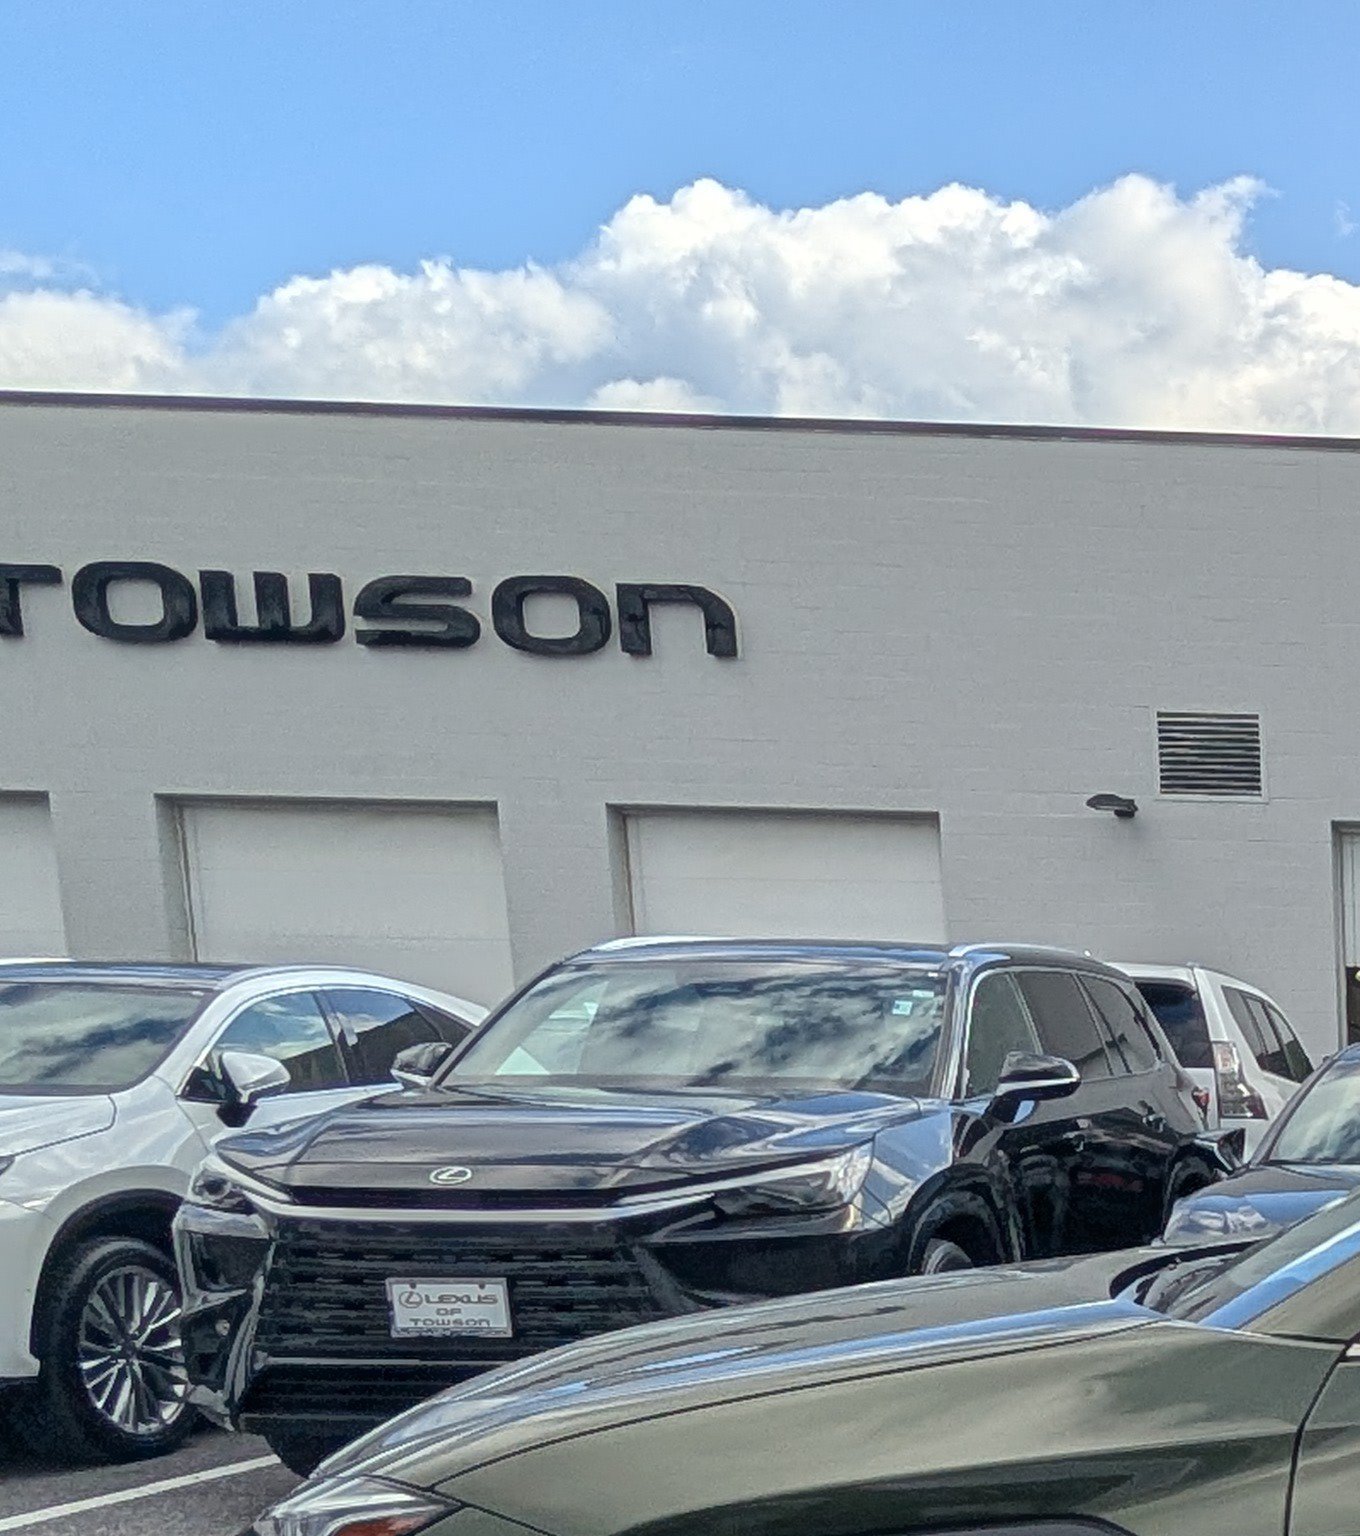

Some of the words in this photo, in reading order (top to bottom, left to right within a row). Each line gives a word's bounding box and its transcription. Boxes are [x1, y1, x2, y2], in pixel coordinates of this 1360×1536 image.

[424, 1293, 498, 1305] LEXUS
[435, 1307, 462, 1316] OF
[409, 1318, 491, 1327] TOWSON
